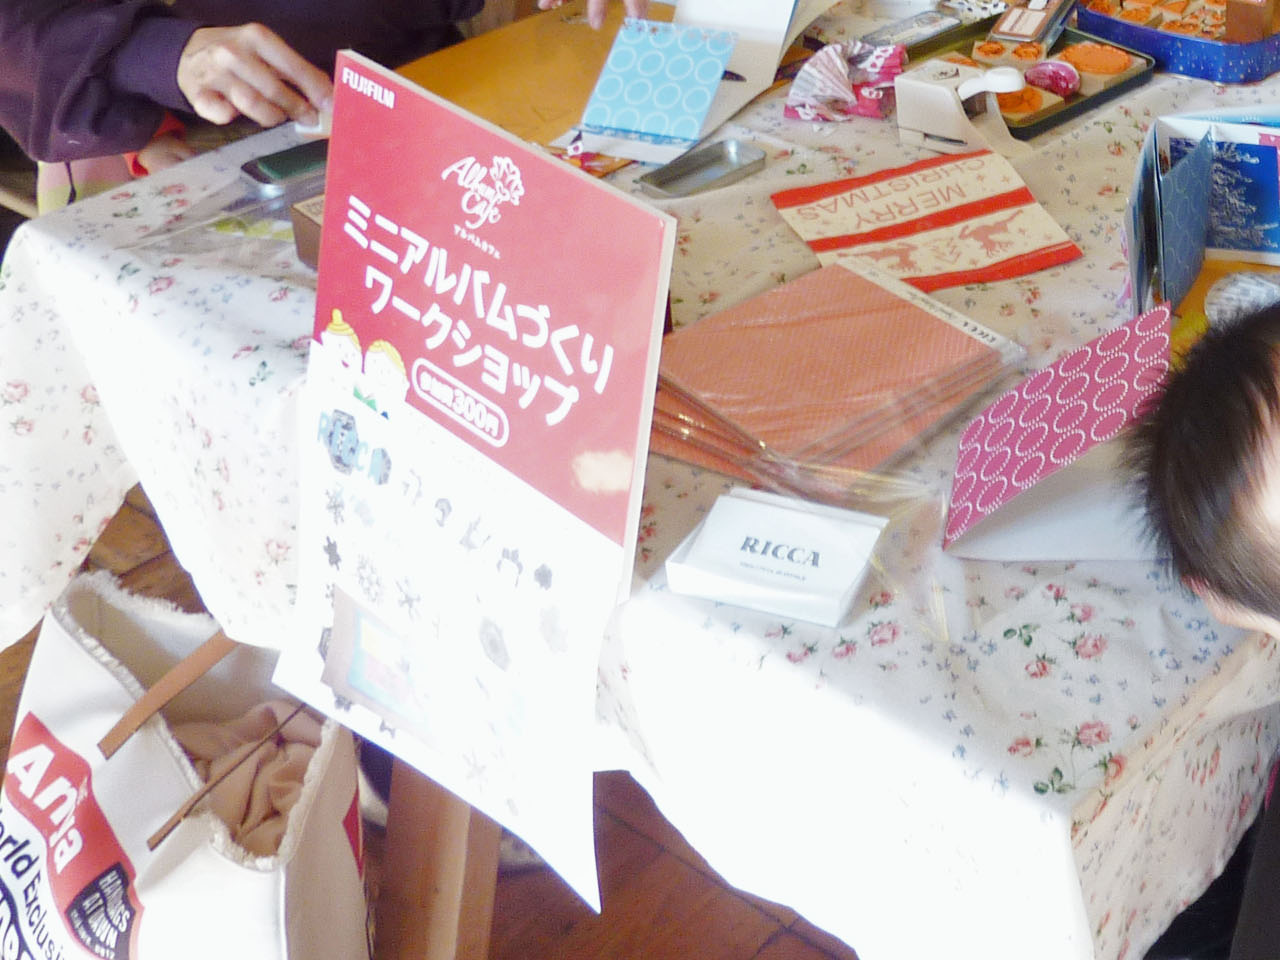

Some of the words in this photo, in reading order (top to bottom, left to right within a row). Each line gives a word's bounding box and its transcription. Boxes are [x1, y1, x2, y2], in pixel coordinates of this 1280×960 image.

[341, 67, 395, 109] FUJIFILM
[796, 158, 985, 221] CHRISTMAS
[856, 183, 967, 229] MERRY
[343, 195, 614, 394] ミニアルバムづくり
[365, 265, 580, 426] ワークショップ
[741, 535, 820, 568] RICCA
[0, 808, 39, 879] rld
[23, 870, 65, 960] Exclusi
